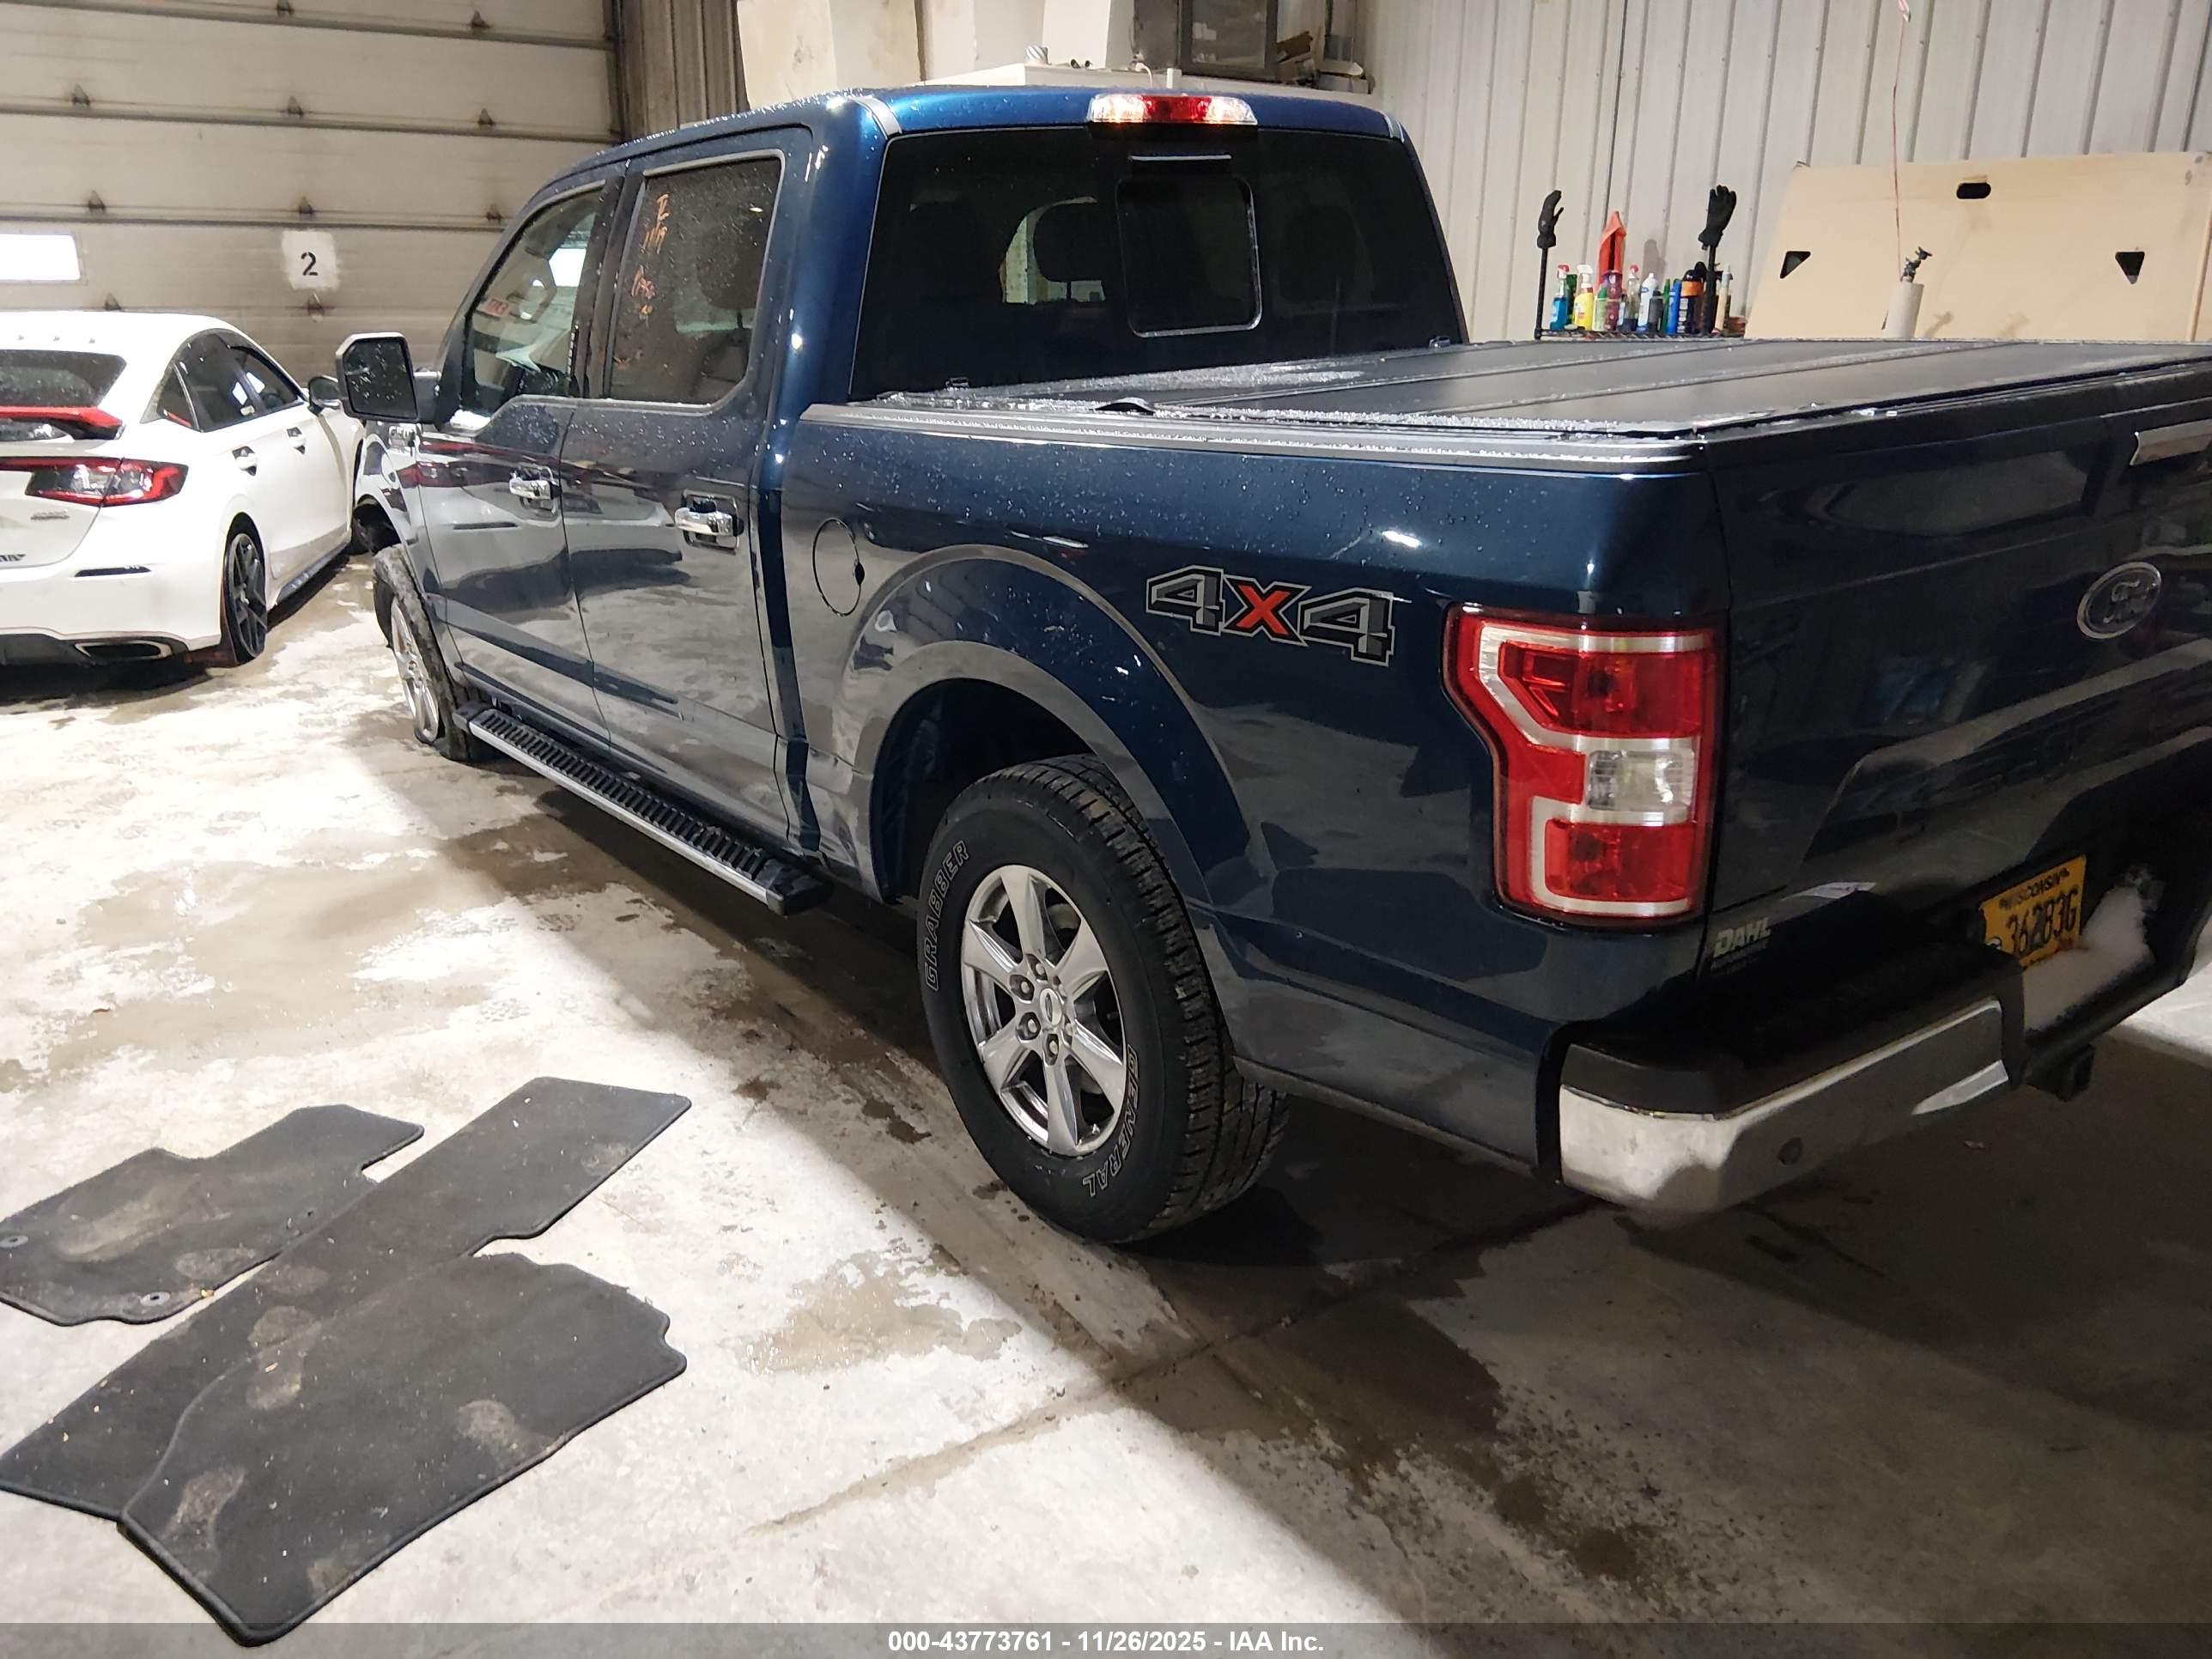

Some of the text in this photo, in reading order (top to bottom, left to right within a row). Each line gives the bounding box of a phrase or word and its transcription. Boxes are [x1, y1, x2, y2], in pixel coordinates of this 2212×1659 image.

[301, 252, 318, 276] 2
[1146, 565, 1395, 666] 4X4
[924, 840, 969, 991] GRABBER
[1712, 916, 1772, 958] DAHL
[1082, 1043, 1139, 1197] GENERAL
